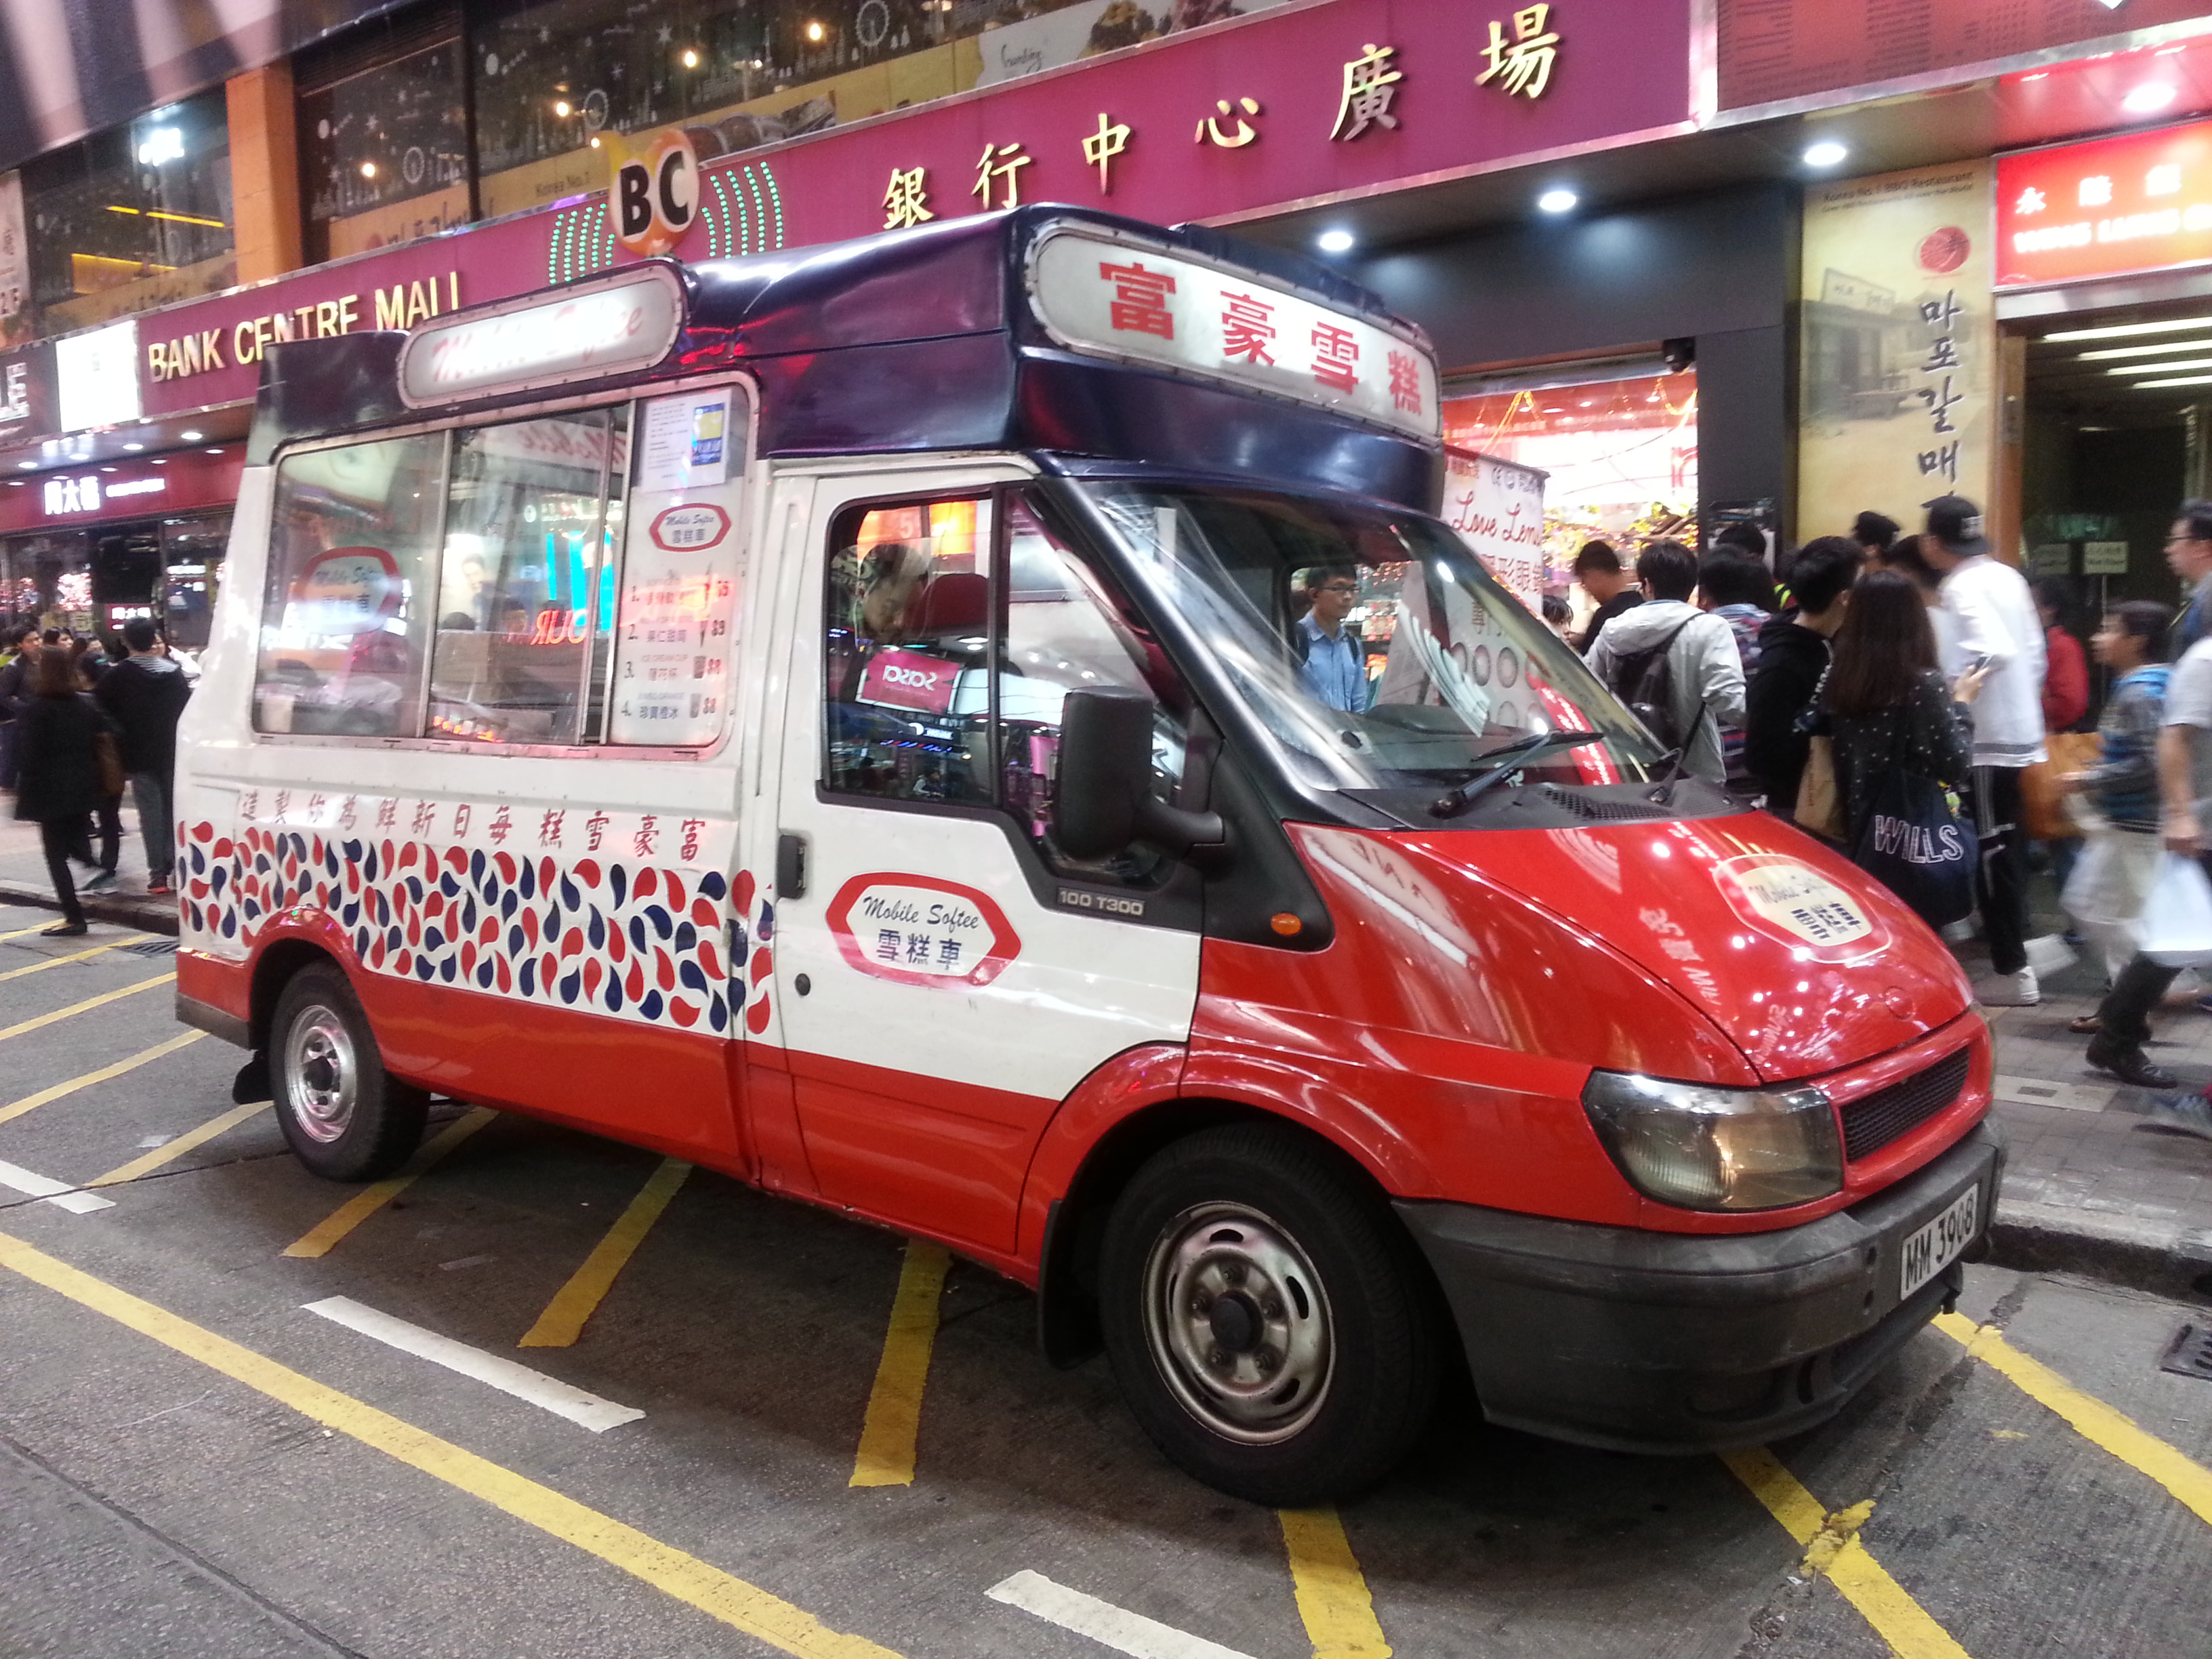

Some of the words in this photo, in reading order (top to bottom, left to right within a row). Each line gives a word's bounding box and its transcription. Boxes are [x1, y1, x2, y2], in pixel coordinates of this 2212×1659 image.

[882, 3, 1561, 229] 銀行中心廣場
[620, 150, 689, 237] BC
[148, 328, 226, 384] BANK
[1099, 262, 1422, 415] 富豪雪糕
[1918, 289, 1965, 499] 마포갈매
[1452, 490, 1498, 539] Love
[1874, 815, 1964, 864] WILLS
[862, 895, 920, 924] Mobile
[926, 903, 980, 935] Softee
[1059, 890, 1092, 908] 100
[1096, 896, 1144, 916] T300
[876, 928, 963, 971] 雪糕車
[1906, 1229, 1931, 1290] MM
[1936, 1192, 1974, 1265] 3908
